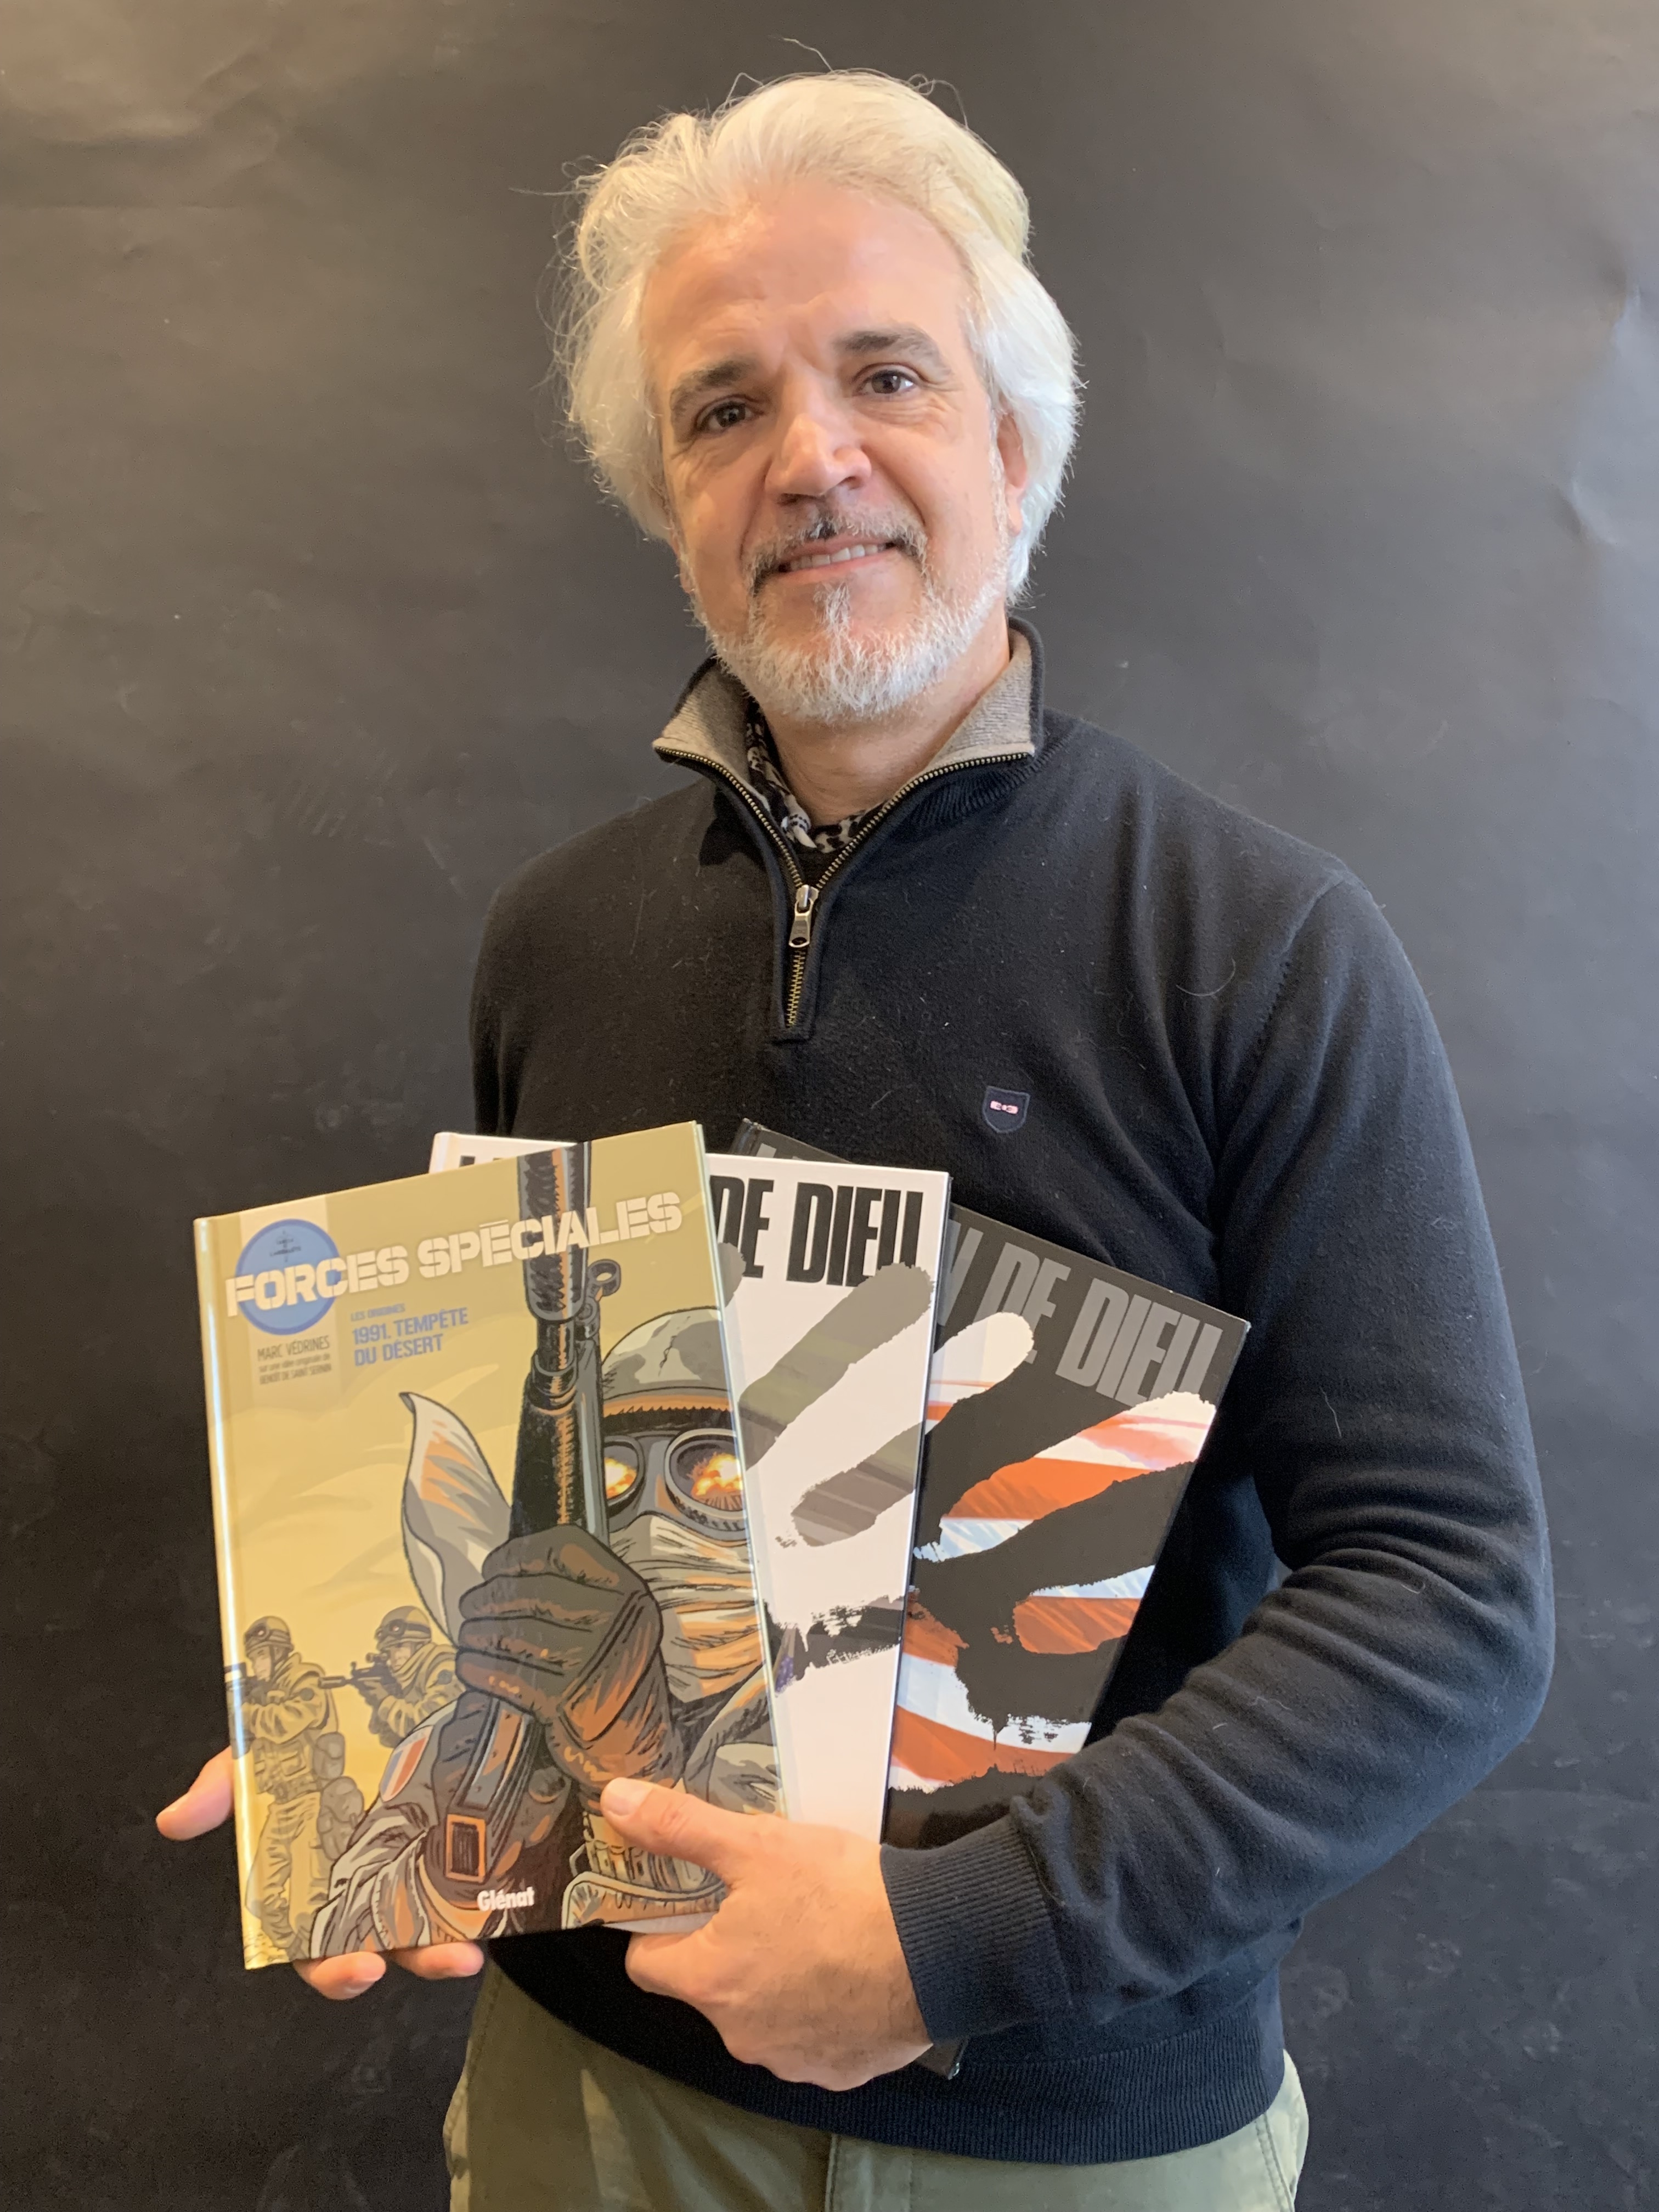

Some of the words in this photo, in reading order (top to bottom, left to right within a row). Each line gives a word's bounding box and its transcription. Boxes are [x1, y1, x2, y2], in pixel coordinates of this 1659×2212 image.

[710, 1175, 774, 1279] DE
[786, 1182, 924, 1287] DIEU
[225, 1245, 409, 1317] FORCES
[352, 1323, 392, 1345] 1991.
[393, 1307, 469, 1337] TEMPÊTE
[1055, 1277, 1223, 1407] DIEU
[257, 1343, 283, 1362] MARC
[285, 1335, 330, 1356] VÉDRINES
[354, 1346, 377, 1367] DU
[382, 1333, 443, 1361] DÉSERT
[477, 1886, 535, 1912] Glénat
